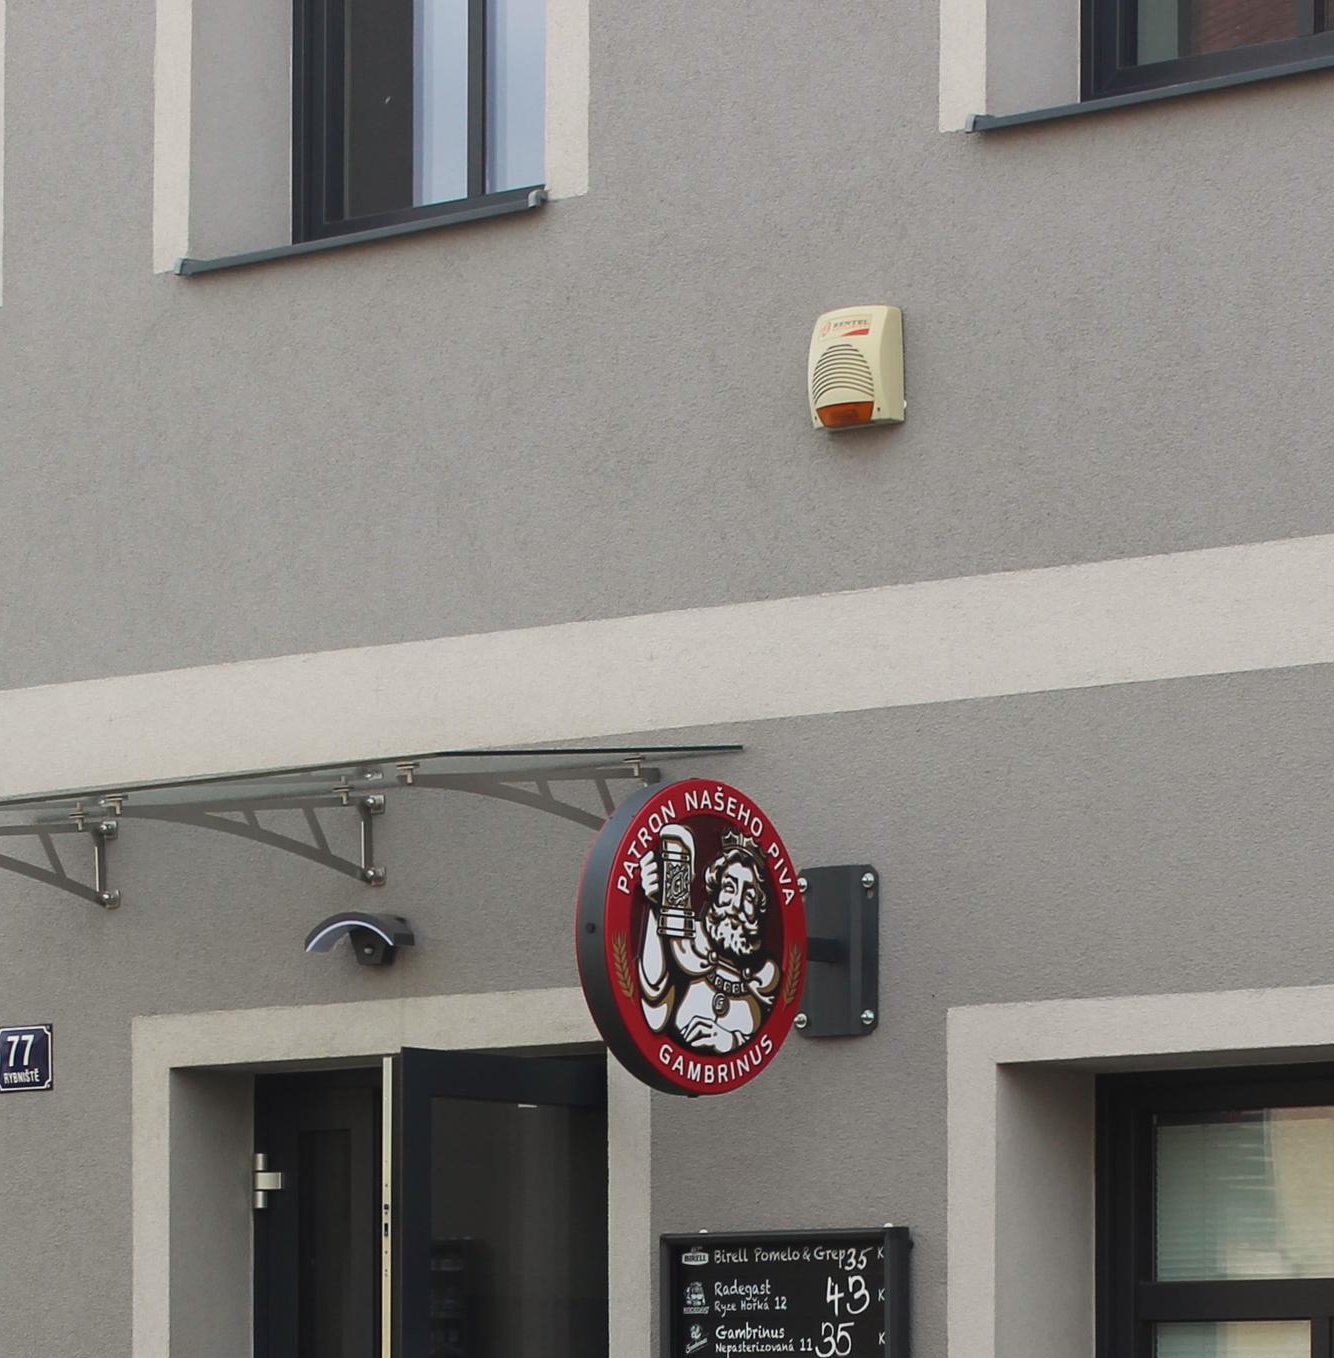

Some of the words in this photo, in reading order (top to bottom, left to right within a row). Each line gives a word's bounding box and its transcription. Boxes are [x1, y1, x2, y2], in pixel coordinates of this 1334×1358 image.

[617, 800, 676, 895] PATRON
[684, 786, 764, 838] NAŠEHO
[767, 842, 795, 905] PIVA
[7, 1034, 34, 1067] 77
[659, 1034, 773, 1084] GAMBRINUS
[714, 1250, 749, 1263] Birell
[754, 1248, 800, 1262] Pomelo
[813, 1246, 845, 1269] Grep
[844, 1247, 873, 1270] 35
[714, 1279, 771, 1298] Radegast
[826, 1275, 870, 1316] 43
[714, 1302, 737, 1317] Ryze
[741, 1297, 769, 1311] Hořká
[774, 1296, 787, 1310] 12
[715, 1321, 785, 1339] Gambrinus
[815, 1322, 855, 1358] 35
[715, 1338, 794, 1358] Nepasterizovaná
[800, 1338, 813, 1351] 11
